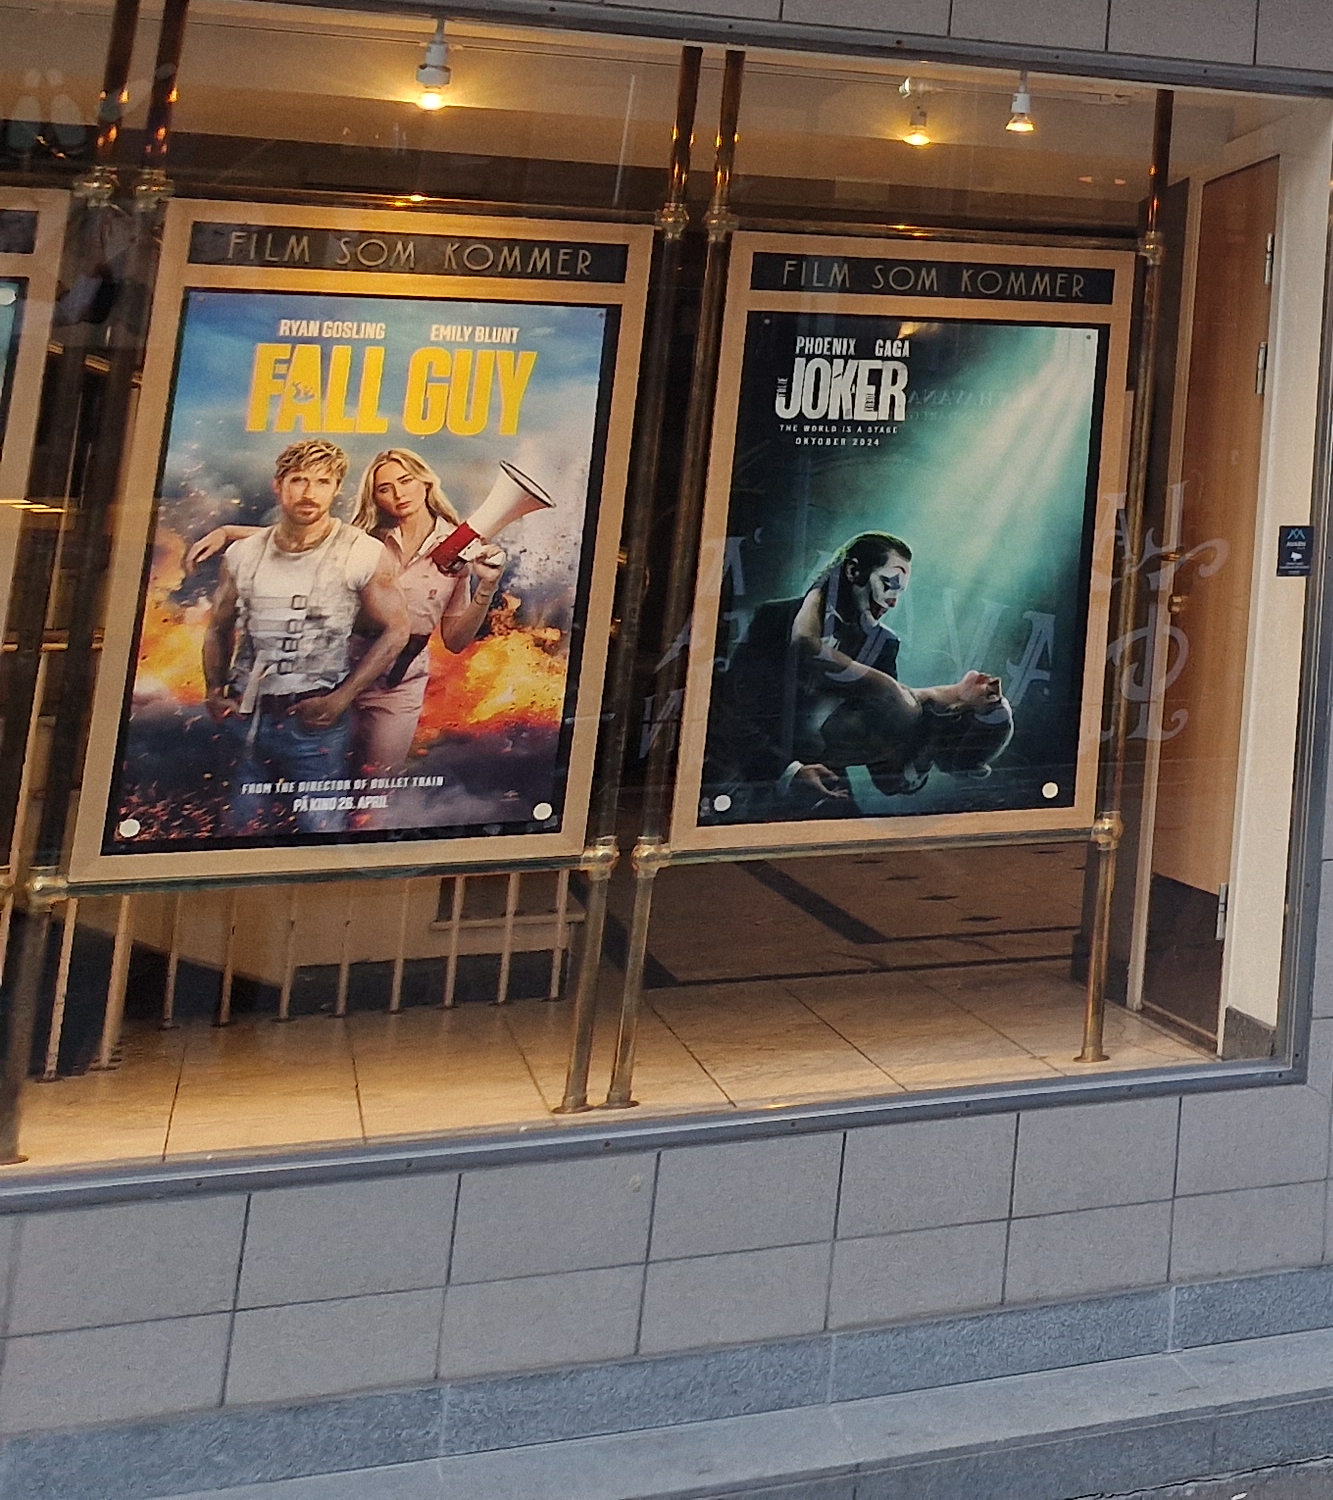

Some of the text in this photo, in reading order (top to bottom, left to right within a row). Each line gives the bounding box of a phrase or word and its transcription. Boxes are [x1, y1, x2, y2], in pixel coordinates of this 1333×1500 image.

[226, 231, 592, 276] FILM SOM KOMMER
[782, 260, 1085, 299] FILM SOM KOMMER
[279, 319, 386, 341] RYAN GOSLING
[430, 324, 520, 344] EMILY BLUNT
[795, 336, 856, 355] PHOENIX
[875, 339, 910, 357] GAGA
[245, 343, 538, 436] FALL GUY
[775, 357, 908, 421] JOKER
[779, 424, 798, 432] THE
[795, 437, 880, 446] OKTOBER 2024
[241, 775, 444, 795] FROM THE DIRECTOR OF BULLET TRAIN
[292, 794, 308, 813] PÅ
[309, 797, 336, 811] KINO
[357, 794, 389, 810] APRIL
